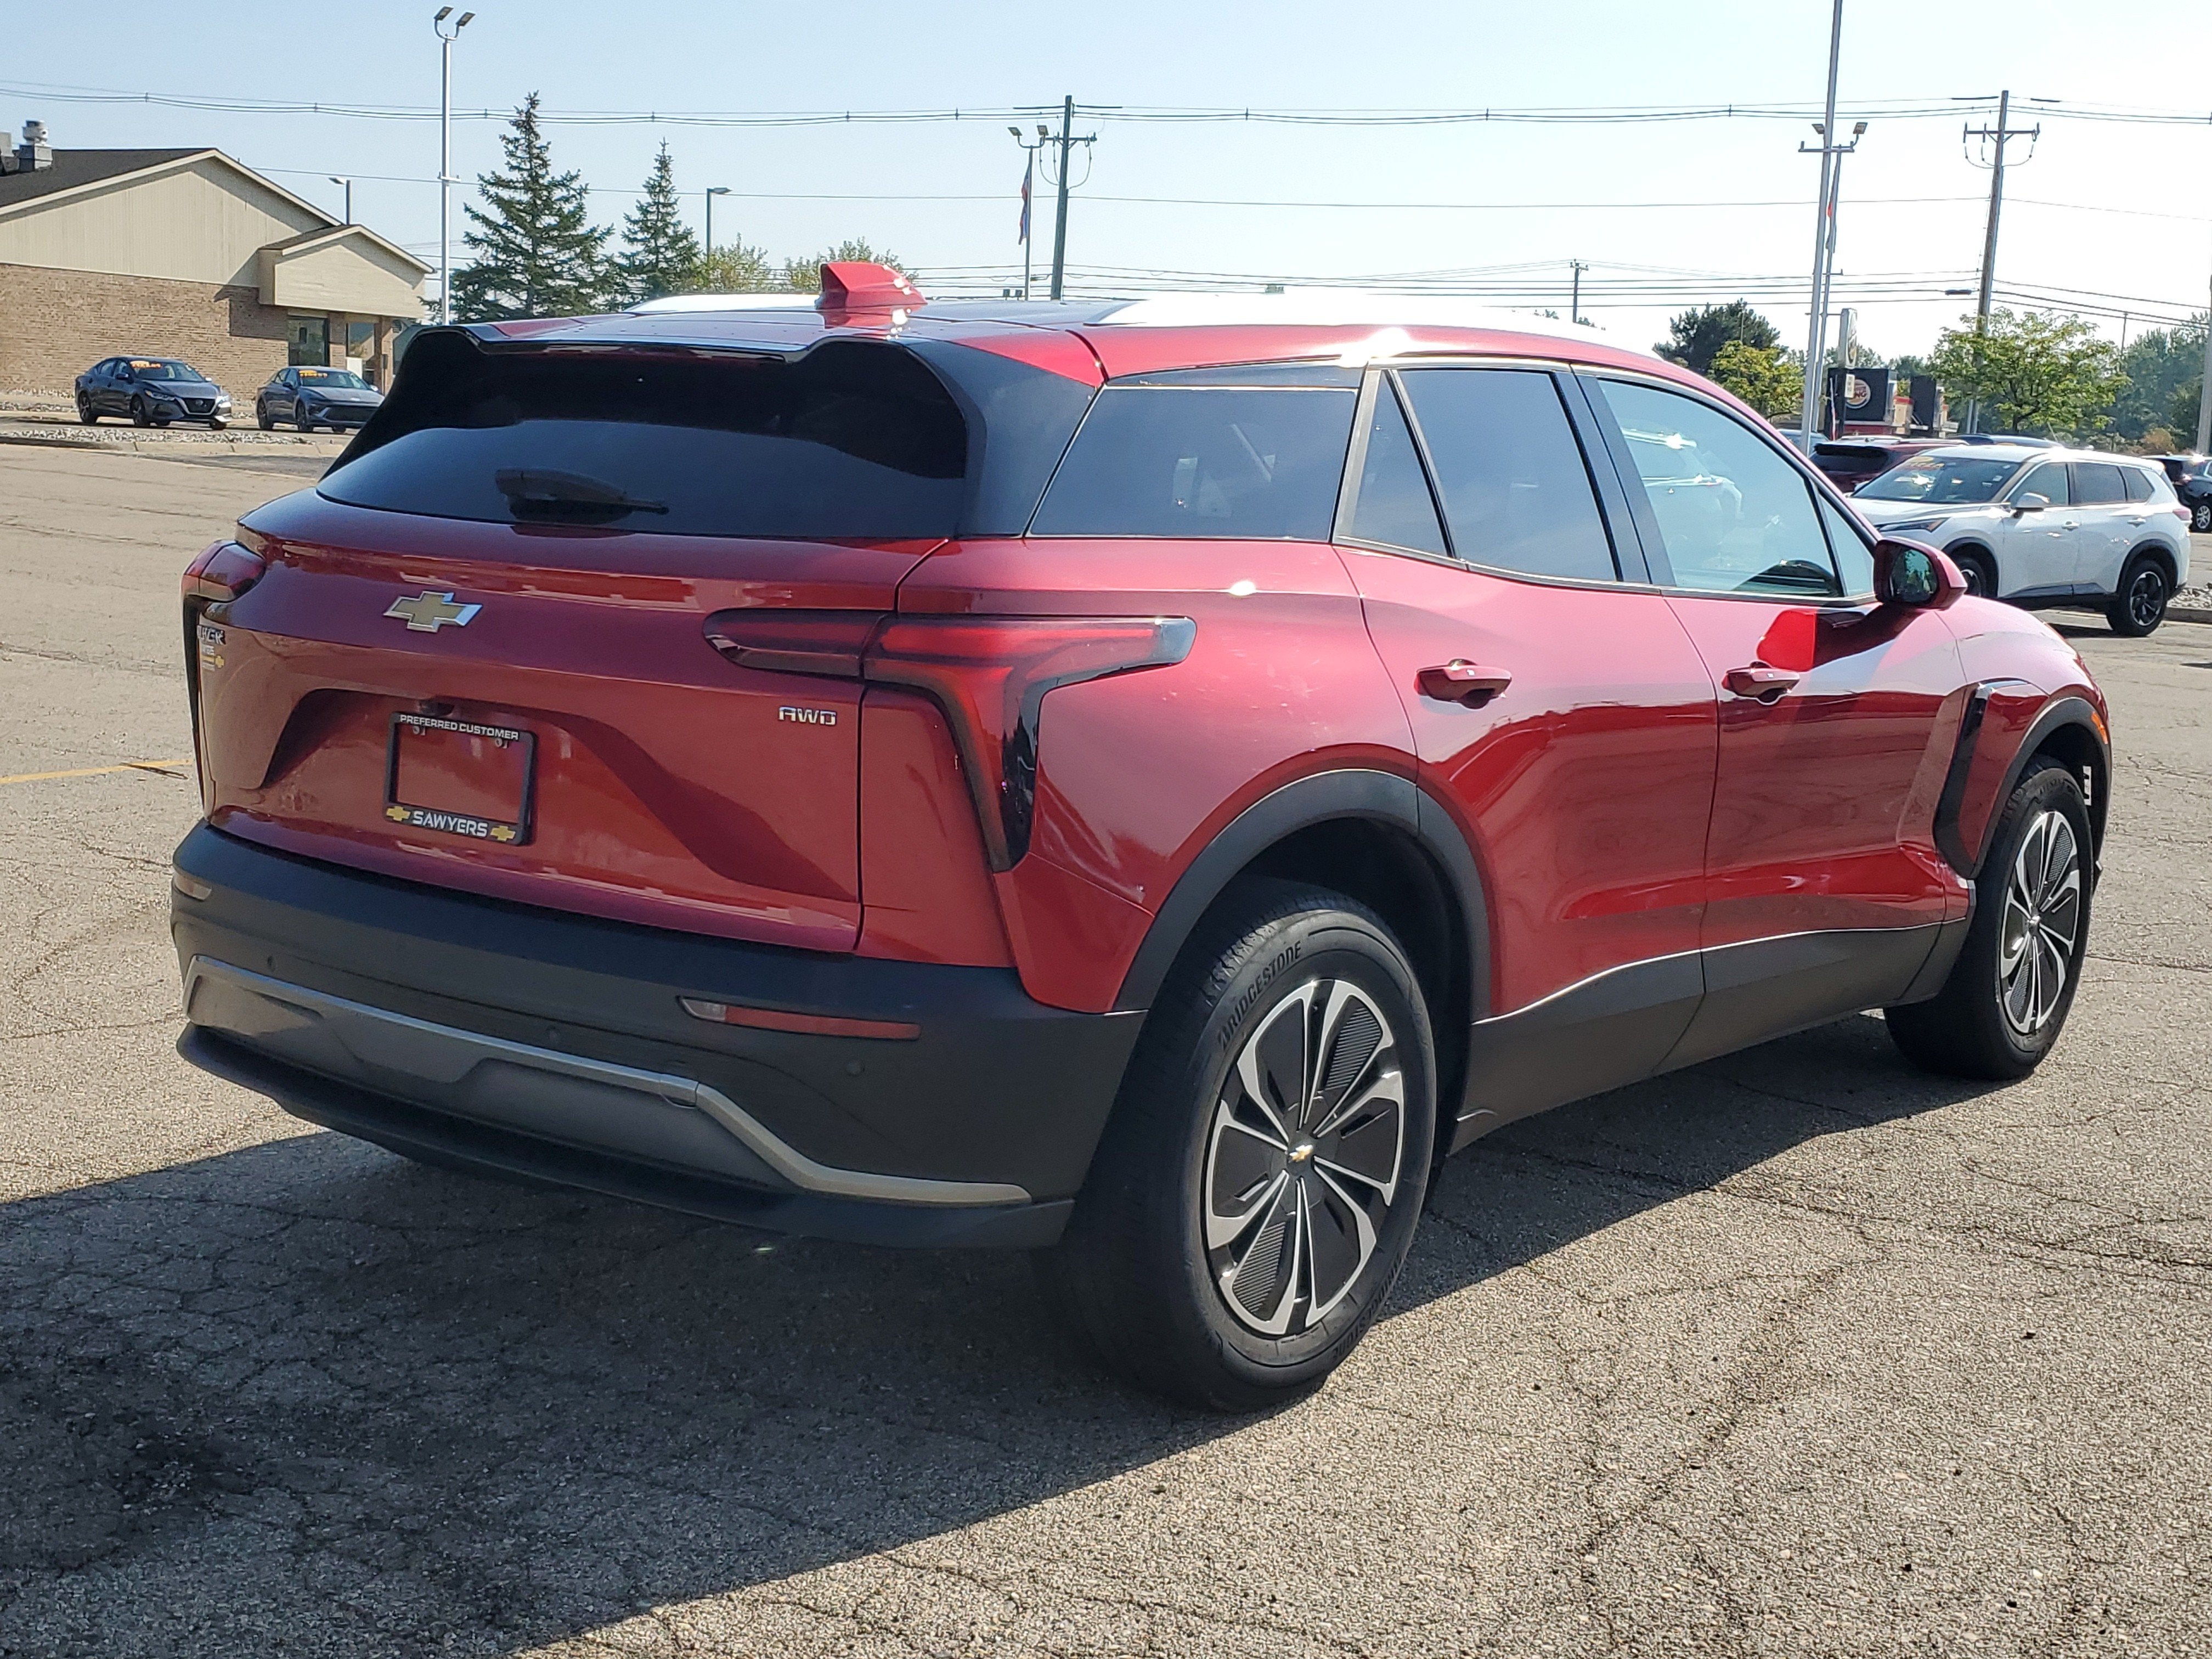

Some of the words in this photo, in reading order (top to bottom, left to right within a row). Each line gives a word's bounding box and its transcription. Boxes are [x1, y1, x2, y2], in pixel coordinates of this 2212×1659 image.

[399, 714, 458, 731] PREFERRED
[459, 724, 519, 740] CUSTOMER
[778, 706, 837, 725] AWD
[413, 810, 488, 837] SAWYERS
[1217, 940, 1301, 1051] BRIDGESTONE
